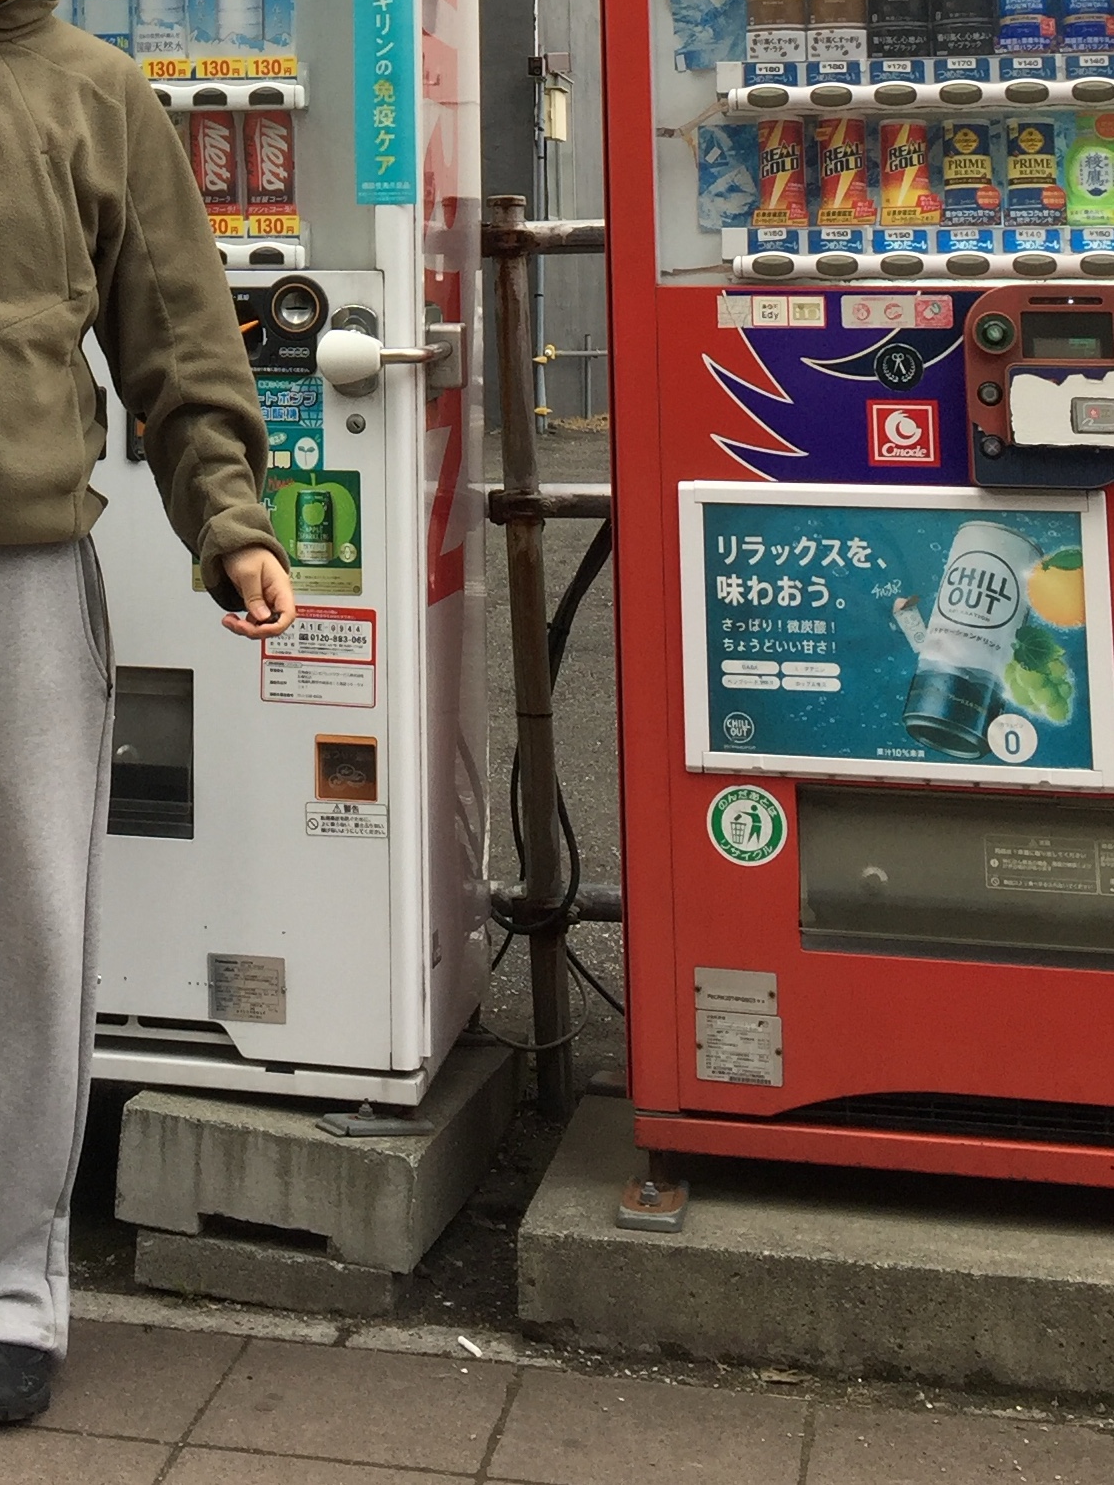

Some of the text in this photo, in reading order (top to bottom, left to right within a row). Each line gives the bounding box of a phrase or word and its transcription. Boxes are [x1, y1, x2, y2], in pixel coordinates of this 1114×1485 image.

[148, 61, 186, 77] 130円
[201, 60, 240, 76] 130円
[253, 59, 292, 75] 130円
[204, 118, 232, 192] Mets
[260, 117, 289, 192] Mets
[761, 141, 799, 164] REAL
[824, 141, 863, 163] REAL
[889, 138, 925, 160] REAL
[761, 157, 800, 179] GOLD
[824, 156, 864, 178] GOLD
[889, 154, 925, 173] GOLD
[948, 158, 987, 170] PRIME
[1013, 158, 1053, 170] PRIME
[208, 218, 239, 235] 30円
[255, 217, 295, 235] 130円
[761, 311, 780, 321] Edy
[881, 442, 927, 458] Cmode
[716, 534, 888, 570] リラックスを、
[716, 575, 846, 610] 味わおう。
[946, 566, 1013, 603] CHILL
[948, 586, 1001, 616] OUT
[726, 718, 751, 729] CHILL
[729, 727, 748, 737] OUT
[1004, 730, 1021, 755] 0
[717, 789, 778, 819] のんだあとは
[720, 838, 773, 861] リサイクル
